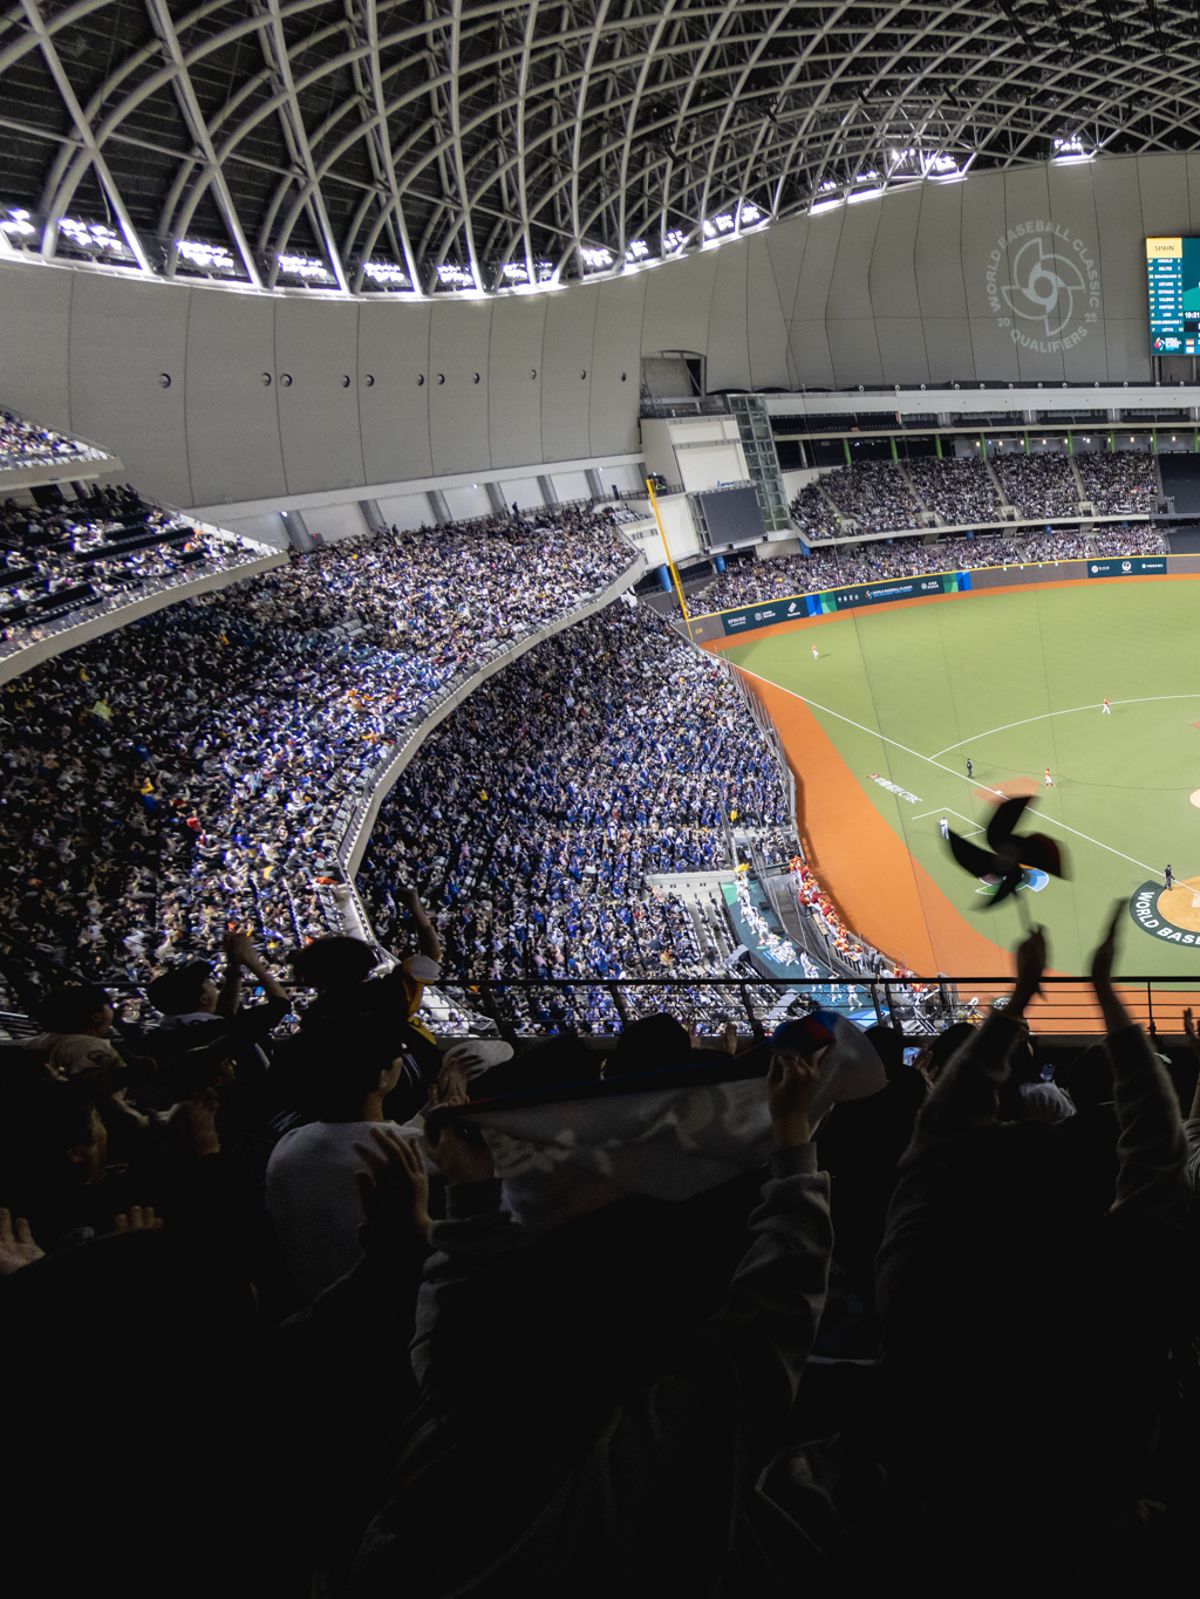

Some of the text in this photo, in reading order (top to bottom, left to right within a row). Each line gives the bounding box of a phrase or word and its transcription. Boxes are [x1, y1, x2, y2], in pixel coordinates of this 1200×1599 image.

[985, 249, 1001, 313] WORLD
[998, 219, 1071, 250] BASEBALL
[1072, 238, 1100, 308] CLASSIC
[1010, 326, 1088, 353] QUALIFIERS
[1135, 891, 1159, 929] WORLD
